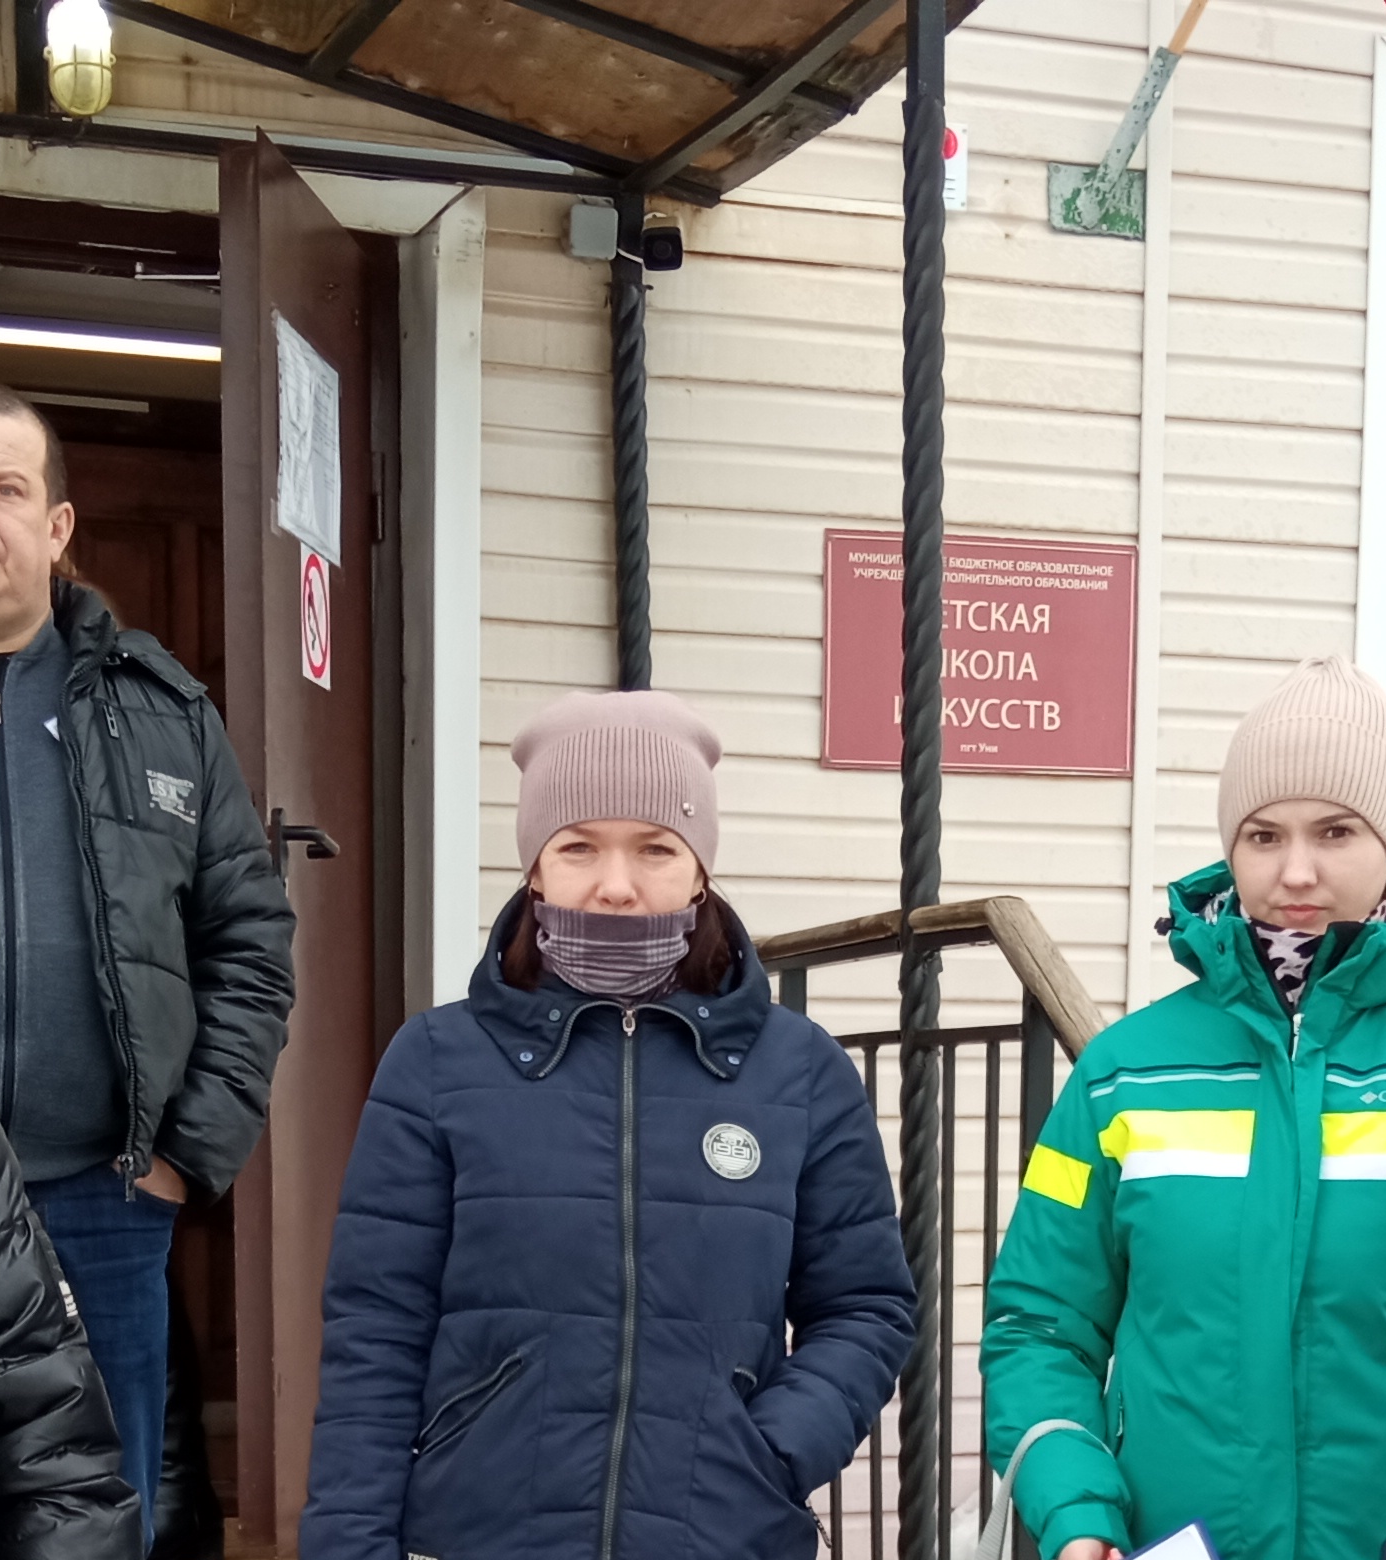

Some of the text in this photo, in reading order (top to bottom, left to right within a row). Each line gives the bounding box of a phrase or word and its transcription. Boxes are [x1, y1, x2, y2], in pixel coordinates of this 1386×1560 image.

[949, 556, 1015, 571] БЮДЖЕТНОЕ
[1016, 560, 1114, 577] ОБРАЗОВАТЕЛЬНОЕ
[853, 567, 1109, 590] УЧРЕЖДЕ ПОЛНИТЕЛЬНОГО ОБРАЗОВАНИЯ
[940, 648, 1039, 681] КОЛА
[893, 695, 1061, 731] КУССТВ
[960, 742, 999, 753] пгт Уни
[713, 1141, 751, 1160] 1981
